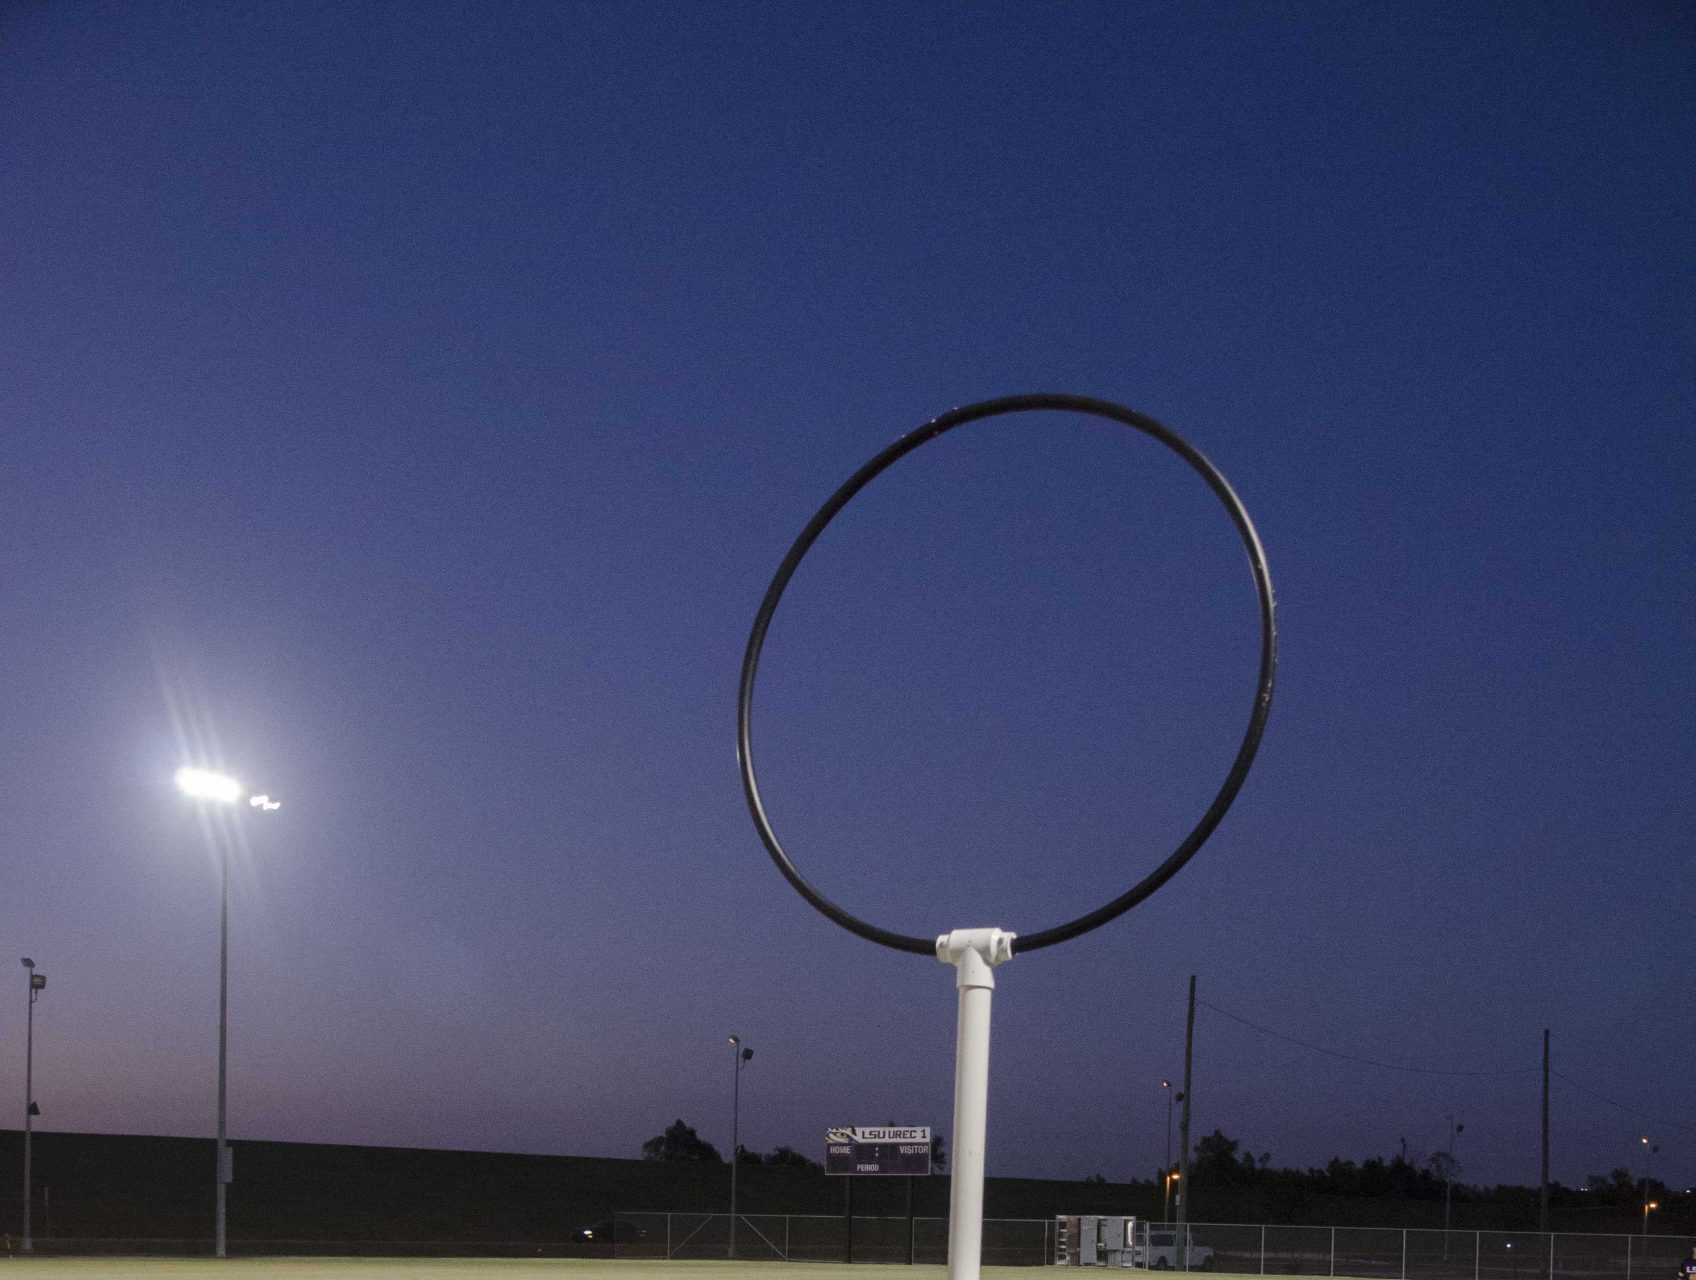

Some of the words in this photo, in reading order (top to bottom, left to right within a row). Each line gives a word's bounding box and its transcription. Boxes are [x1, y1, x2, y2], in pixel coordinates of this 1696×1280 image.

[862, 1130, 886, 1139] LSU
[888, 1129, 916, 1138] UREC
[921, 1129, 926, 1138] 1
[830, 1146, 850, 1154] HOME
[899, 1146, 928, 1154] VISITOR
[857, 1164, 879, 1172] PERIOD
